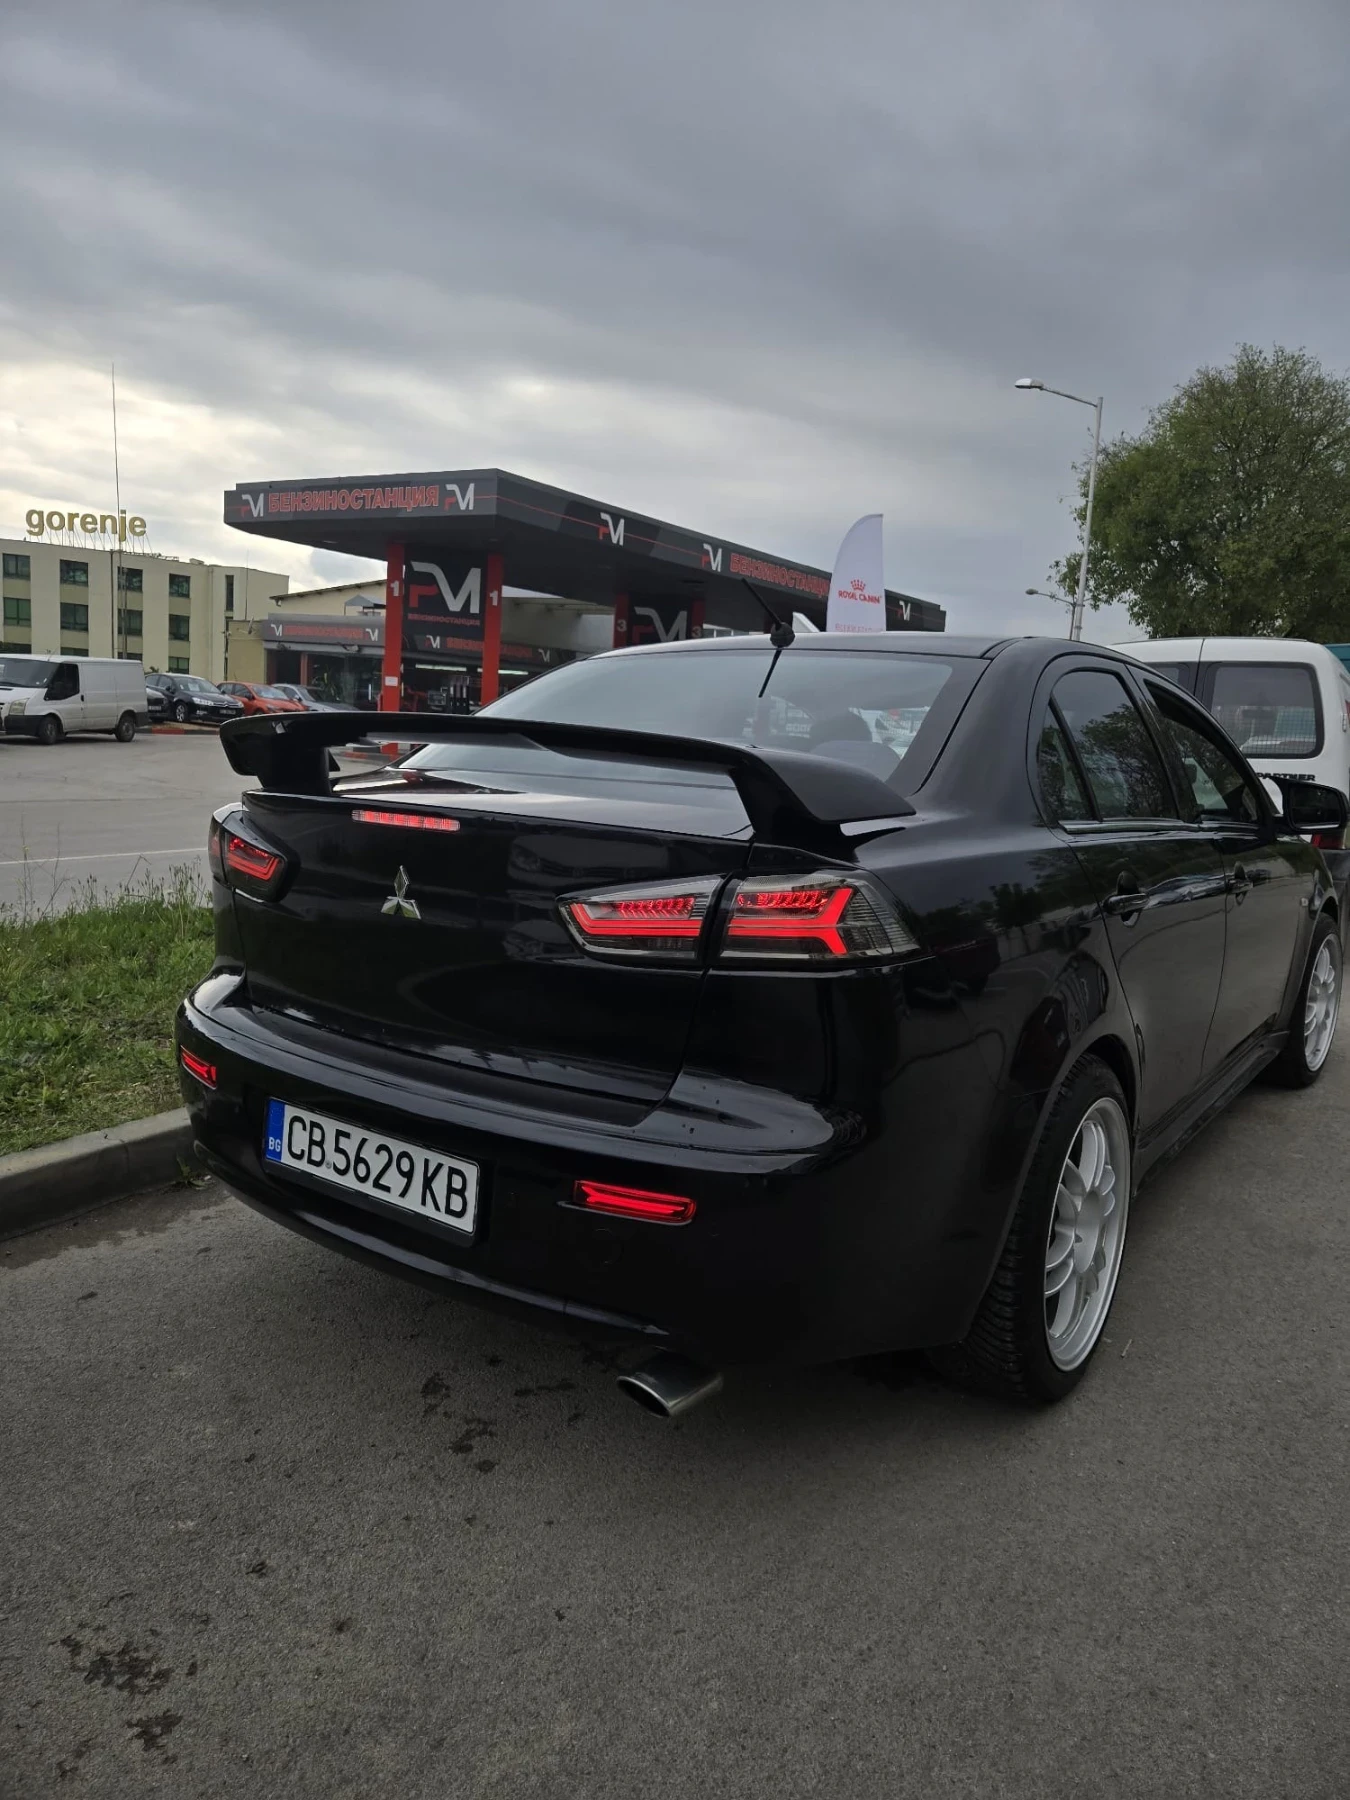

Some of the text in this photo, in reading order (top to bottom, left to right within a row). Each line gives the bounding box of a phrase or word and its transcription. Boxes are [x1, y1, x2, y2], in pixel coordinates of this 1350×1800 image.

[268, 486, 439, 512] БЕНЗИНОСТАНЦИЯ
[26, 509, 147, 543] gorenje
[391, 580, 400, 597] 1
[838, 589, 881, 605] ROYAL CANIN
[490, 590, 499, 607] 1
[616, 619, 628, 632] 3
[268, 1135, 282, 1152] BG
